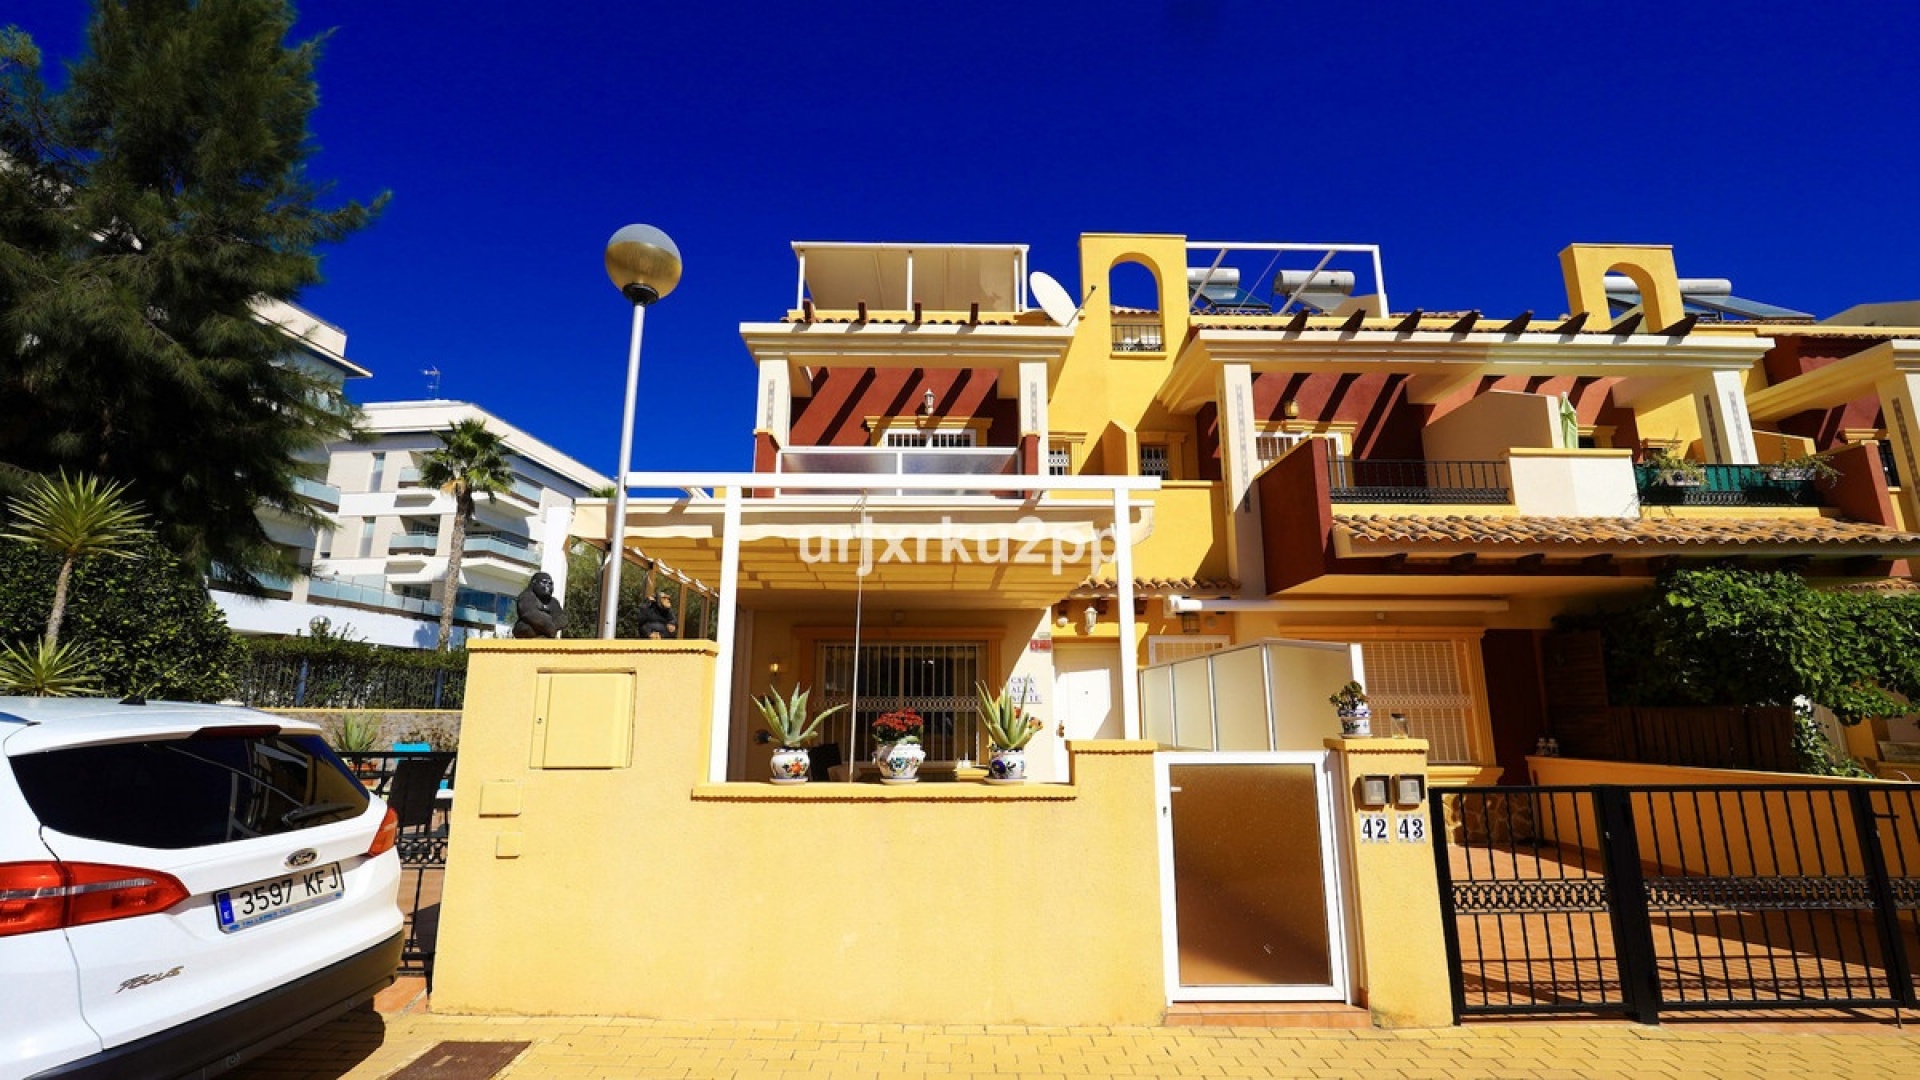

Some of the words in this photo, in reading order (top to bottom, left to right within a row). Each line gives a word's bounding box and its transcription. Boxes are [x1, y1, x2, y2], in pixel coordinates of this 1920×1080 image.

[1362, 818, 1387, 839] 42
[1399, 818, 1424, 839] 43
[240, 879, 293, 915] 3597
[303, 866, 338, 896] KFJ
